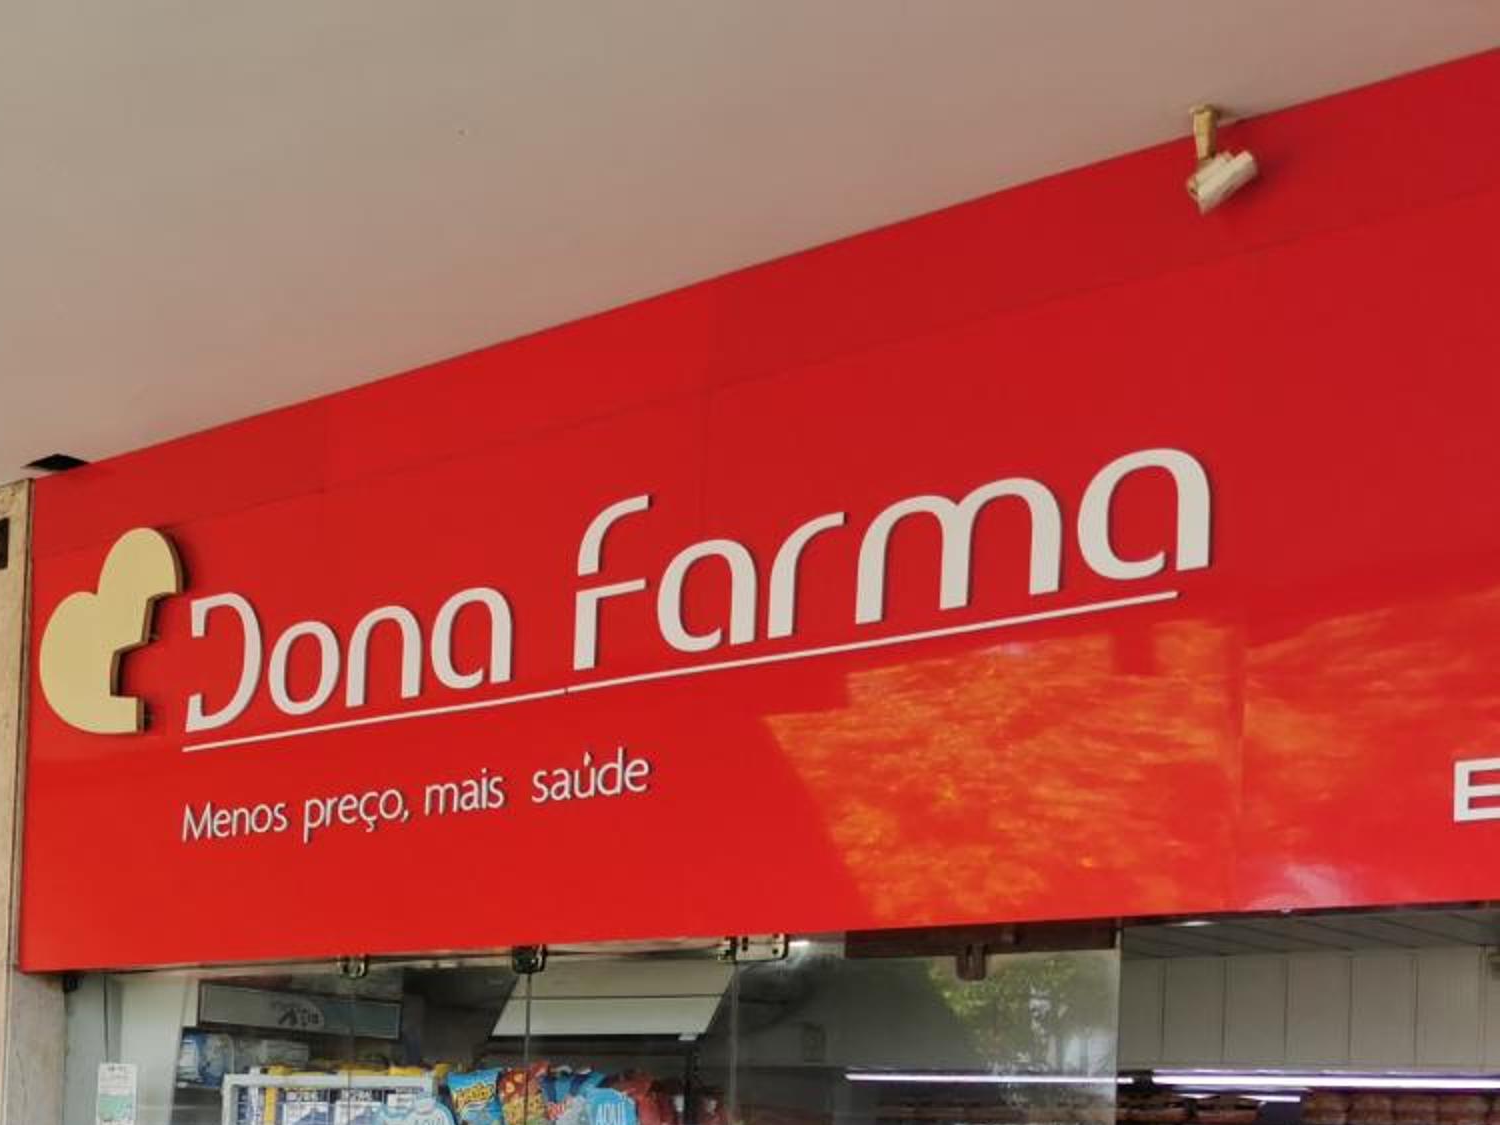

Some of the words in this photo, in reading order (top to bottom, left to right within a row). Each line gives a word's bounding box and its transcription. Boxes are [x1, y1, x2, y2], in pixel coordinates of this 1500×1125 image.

[185, 587, 512, 733] Dona
[183, 803, 288, 842] Menos
[303, 788, 409, 843] preço,
[424, 767, 504, 816] mais
[531, 746, 651, 803] saúde
